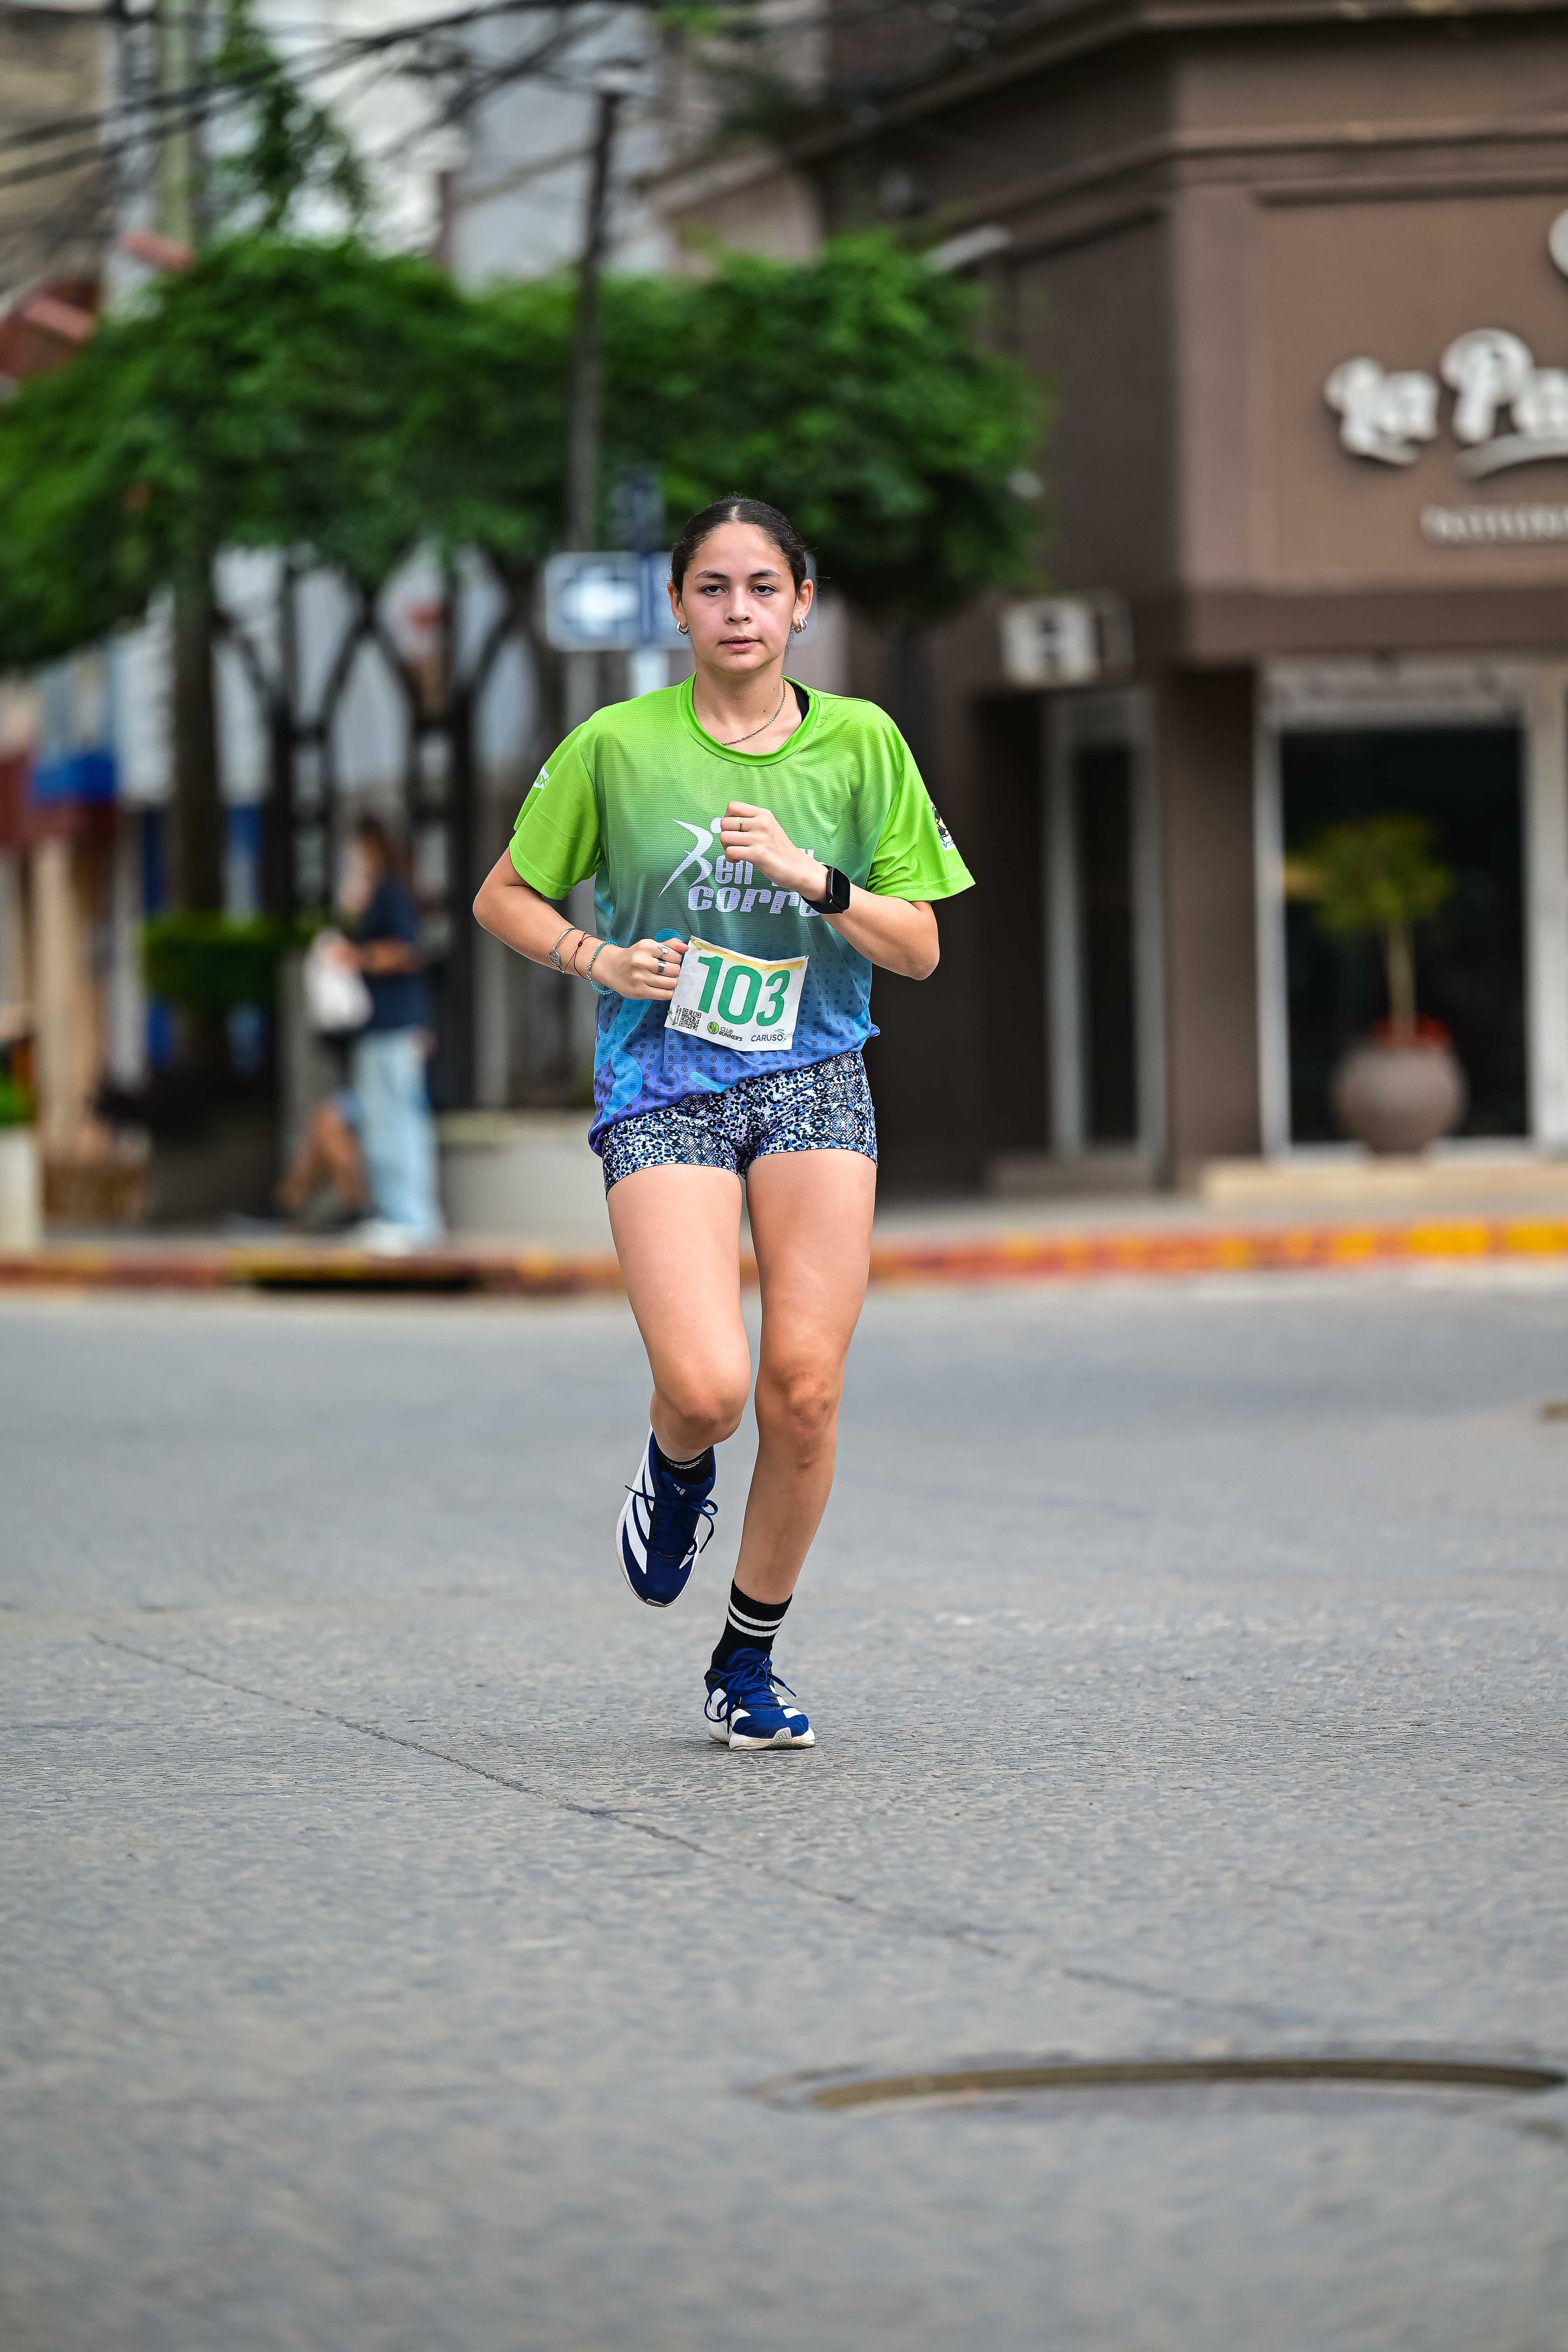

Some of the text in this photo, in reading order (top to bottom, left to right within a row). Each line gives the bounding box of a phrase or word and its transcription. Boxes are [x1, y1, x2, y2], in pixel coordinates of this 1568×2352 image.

[698, 956, 791, 1027] 103
[718, 1031, 743, 1041] RUNNER'S
[751, 1033, 784, 1042] CARUSO
